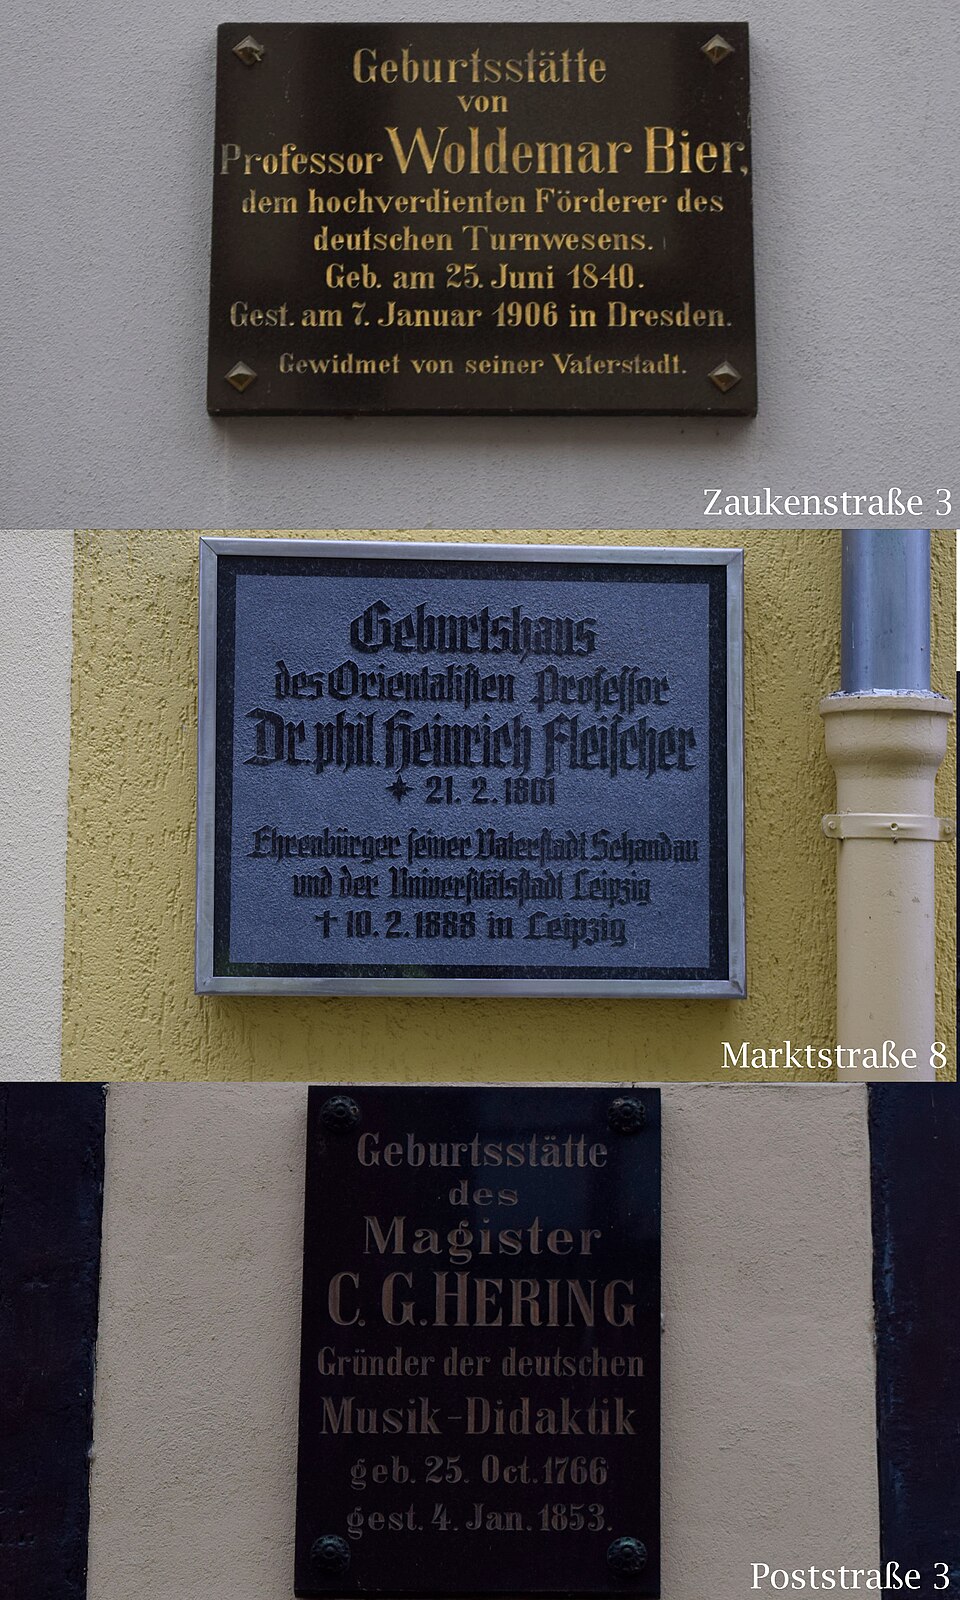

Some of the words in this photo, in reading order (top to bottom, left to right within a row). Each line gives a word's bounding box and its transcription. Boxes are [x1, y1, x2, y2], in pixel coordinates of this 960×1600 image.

[353, 48, 607, 84] Geburtsstätte
[456, 94, 509, 114] von
[220, 143, 384, 176] Professor
[385, 126, 632, 175] Woldemar
[644, 126, 750, 178] Bier,
[241, 189, 298, 214] dem
[308, 188, 526, 214] hochverdienten
[535, 187, 667, 214] Förderer
[677, 188, 724, 213] des
[313, 226, 453, 252] deutschen
[463, 225, 654, 252] Turnwesens.
[325, 264, 382, 290] Geb.
[393, 270, 435, 290] am
[446, 263, 484, 290] 25.
[492, 264, 554, 290] Juni
[566, 263, 645, 290] 1840.
[230, 302, 295, 328] Gest.
[301, 308, 342, 328] am
[351, 302, 370, 328] 7.
[377, 302, 482, 328] Januar
[492, 302, 558, 328] 1906
[569, 302, 597, 328] in
[608, 302, 732, 328] Dresden.
[279, 353, 400, 376] Gewidmet
[411, 358, 454, 376] von
[465, 355, 544, 376] seiner
[552, 352, 688, 375] Vaterstadt.
[350, 600, 599, 663] Geburtshaus
[274, 660, 324, 700] des
[425, 775, 462, 804] 21.
[247, 825, 402, 864] Ehrenbürger
[591, 829, 699, 867] Schandau
[291, 865, 332, 898] und
[338, 865, 380, 898] der
[569, 867, 652, 907] Leipzig
[486, 911, 513, 939] in
[523, 911, 629, 949] Leipzig
[357, 1132, 608, 1168] Geburtsstätte
[449, 1180, 519, 1206] des
[363, 1215, 603, 1265] Magister
[328, 1271, 366, 1327] C.
[317, 1346, 436, 1378] Gründer
[443, 1347, 491, 1378] der
[501, 1346, 647, 1378] deutschen
[350, 1455, 417, 1491] geb.
[424, 1455, 470, 1484] 25.
[543, 1455, 609, 1485] 1766
[346, 1503, 424, 1540] gest.
[431, 1503, 459, 1531] 4.
[466, 1503, 533, 1532] Jan.
[538, 1503, 613, 1532] 1853.
